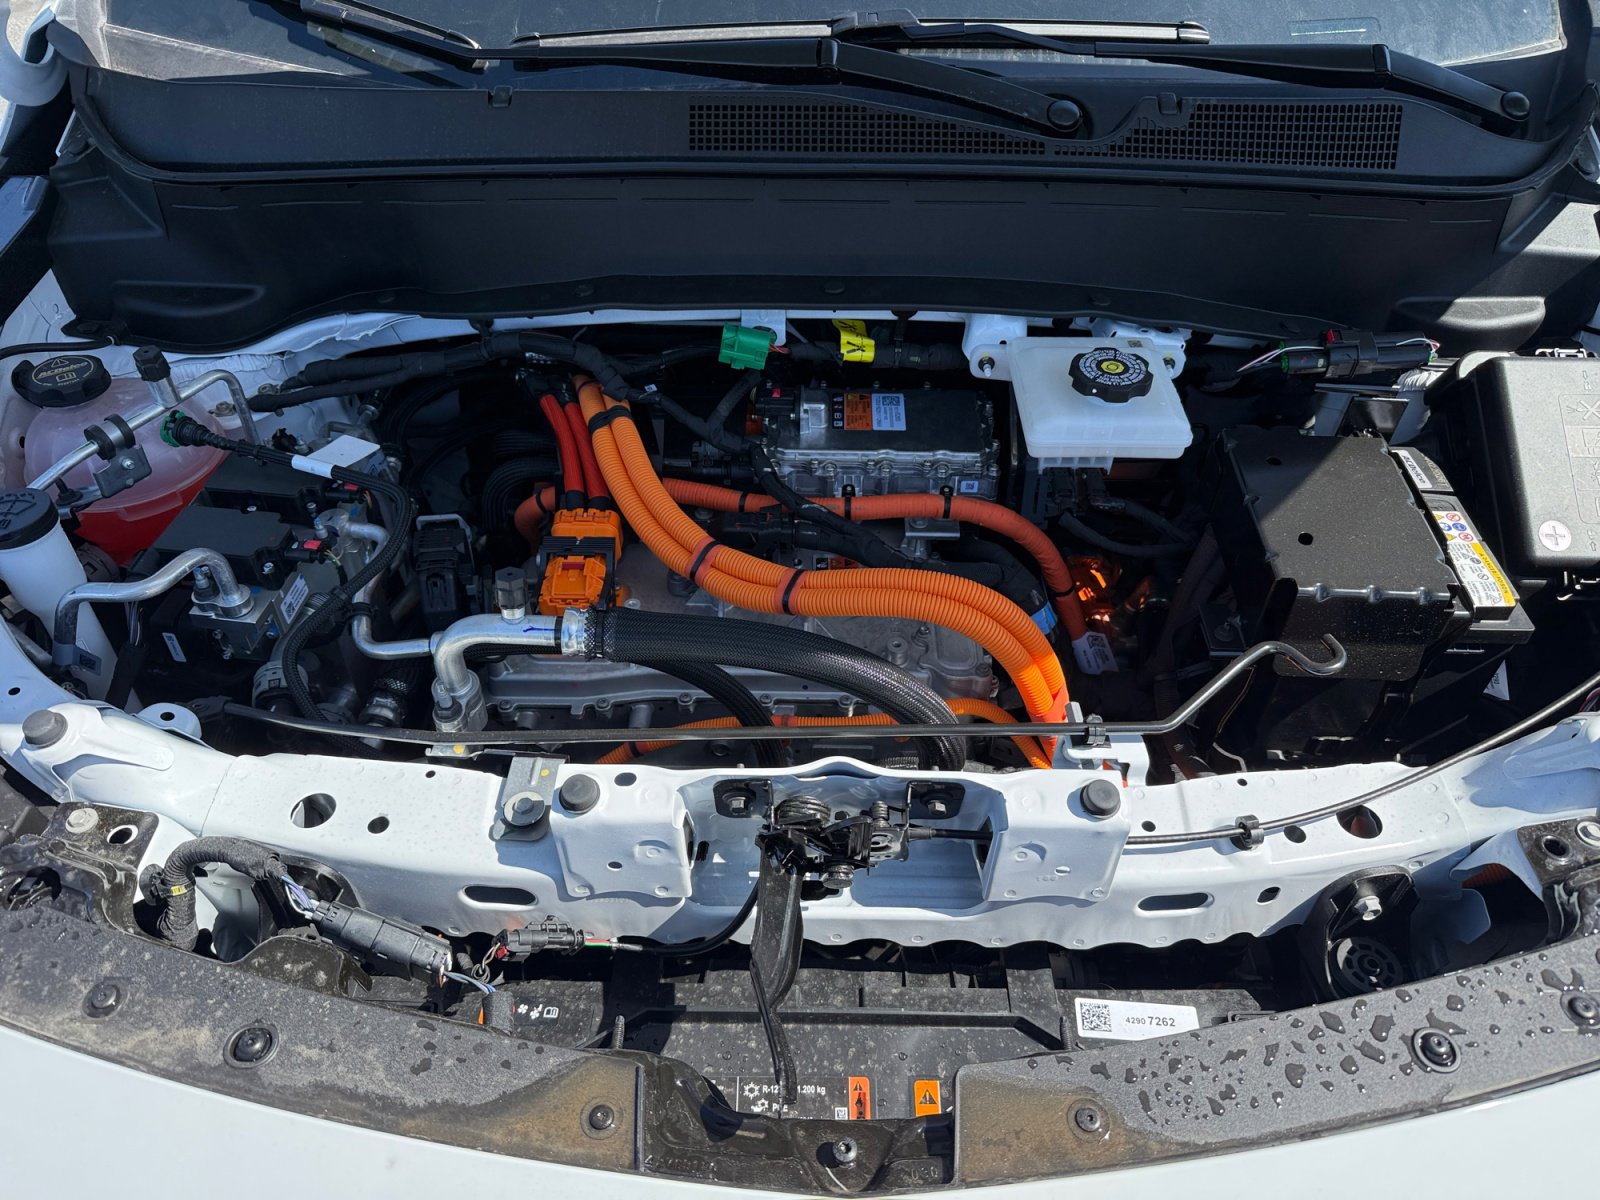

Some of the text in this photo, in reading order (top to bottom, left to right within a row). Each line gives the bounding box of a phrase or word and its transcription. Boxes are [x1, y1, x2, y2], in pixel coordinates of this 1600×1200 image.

[1401, 455, 1426, 484] ACDelco
[1125, 1016, 1176, 1027] 4290 7262
[816, 1085, 826, 1095] kg
